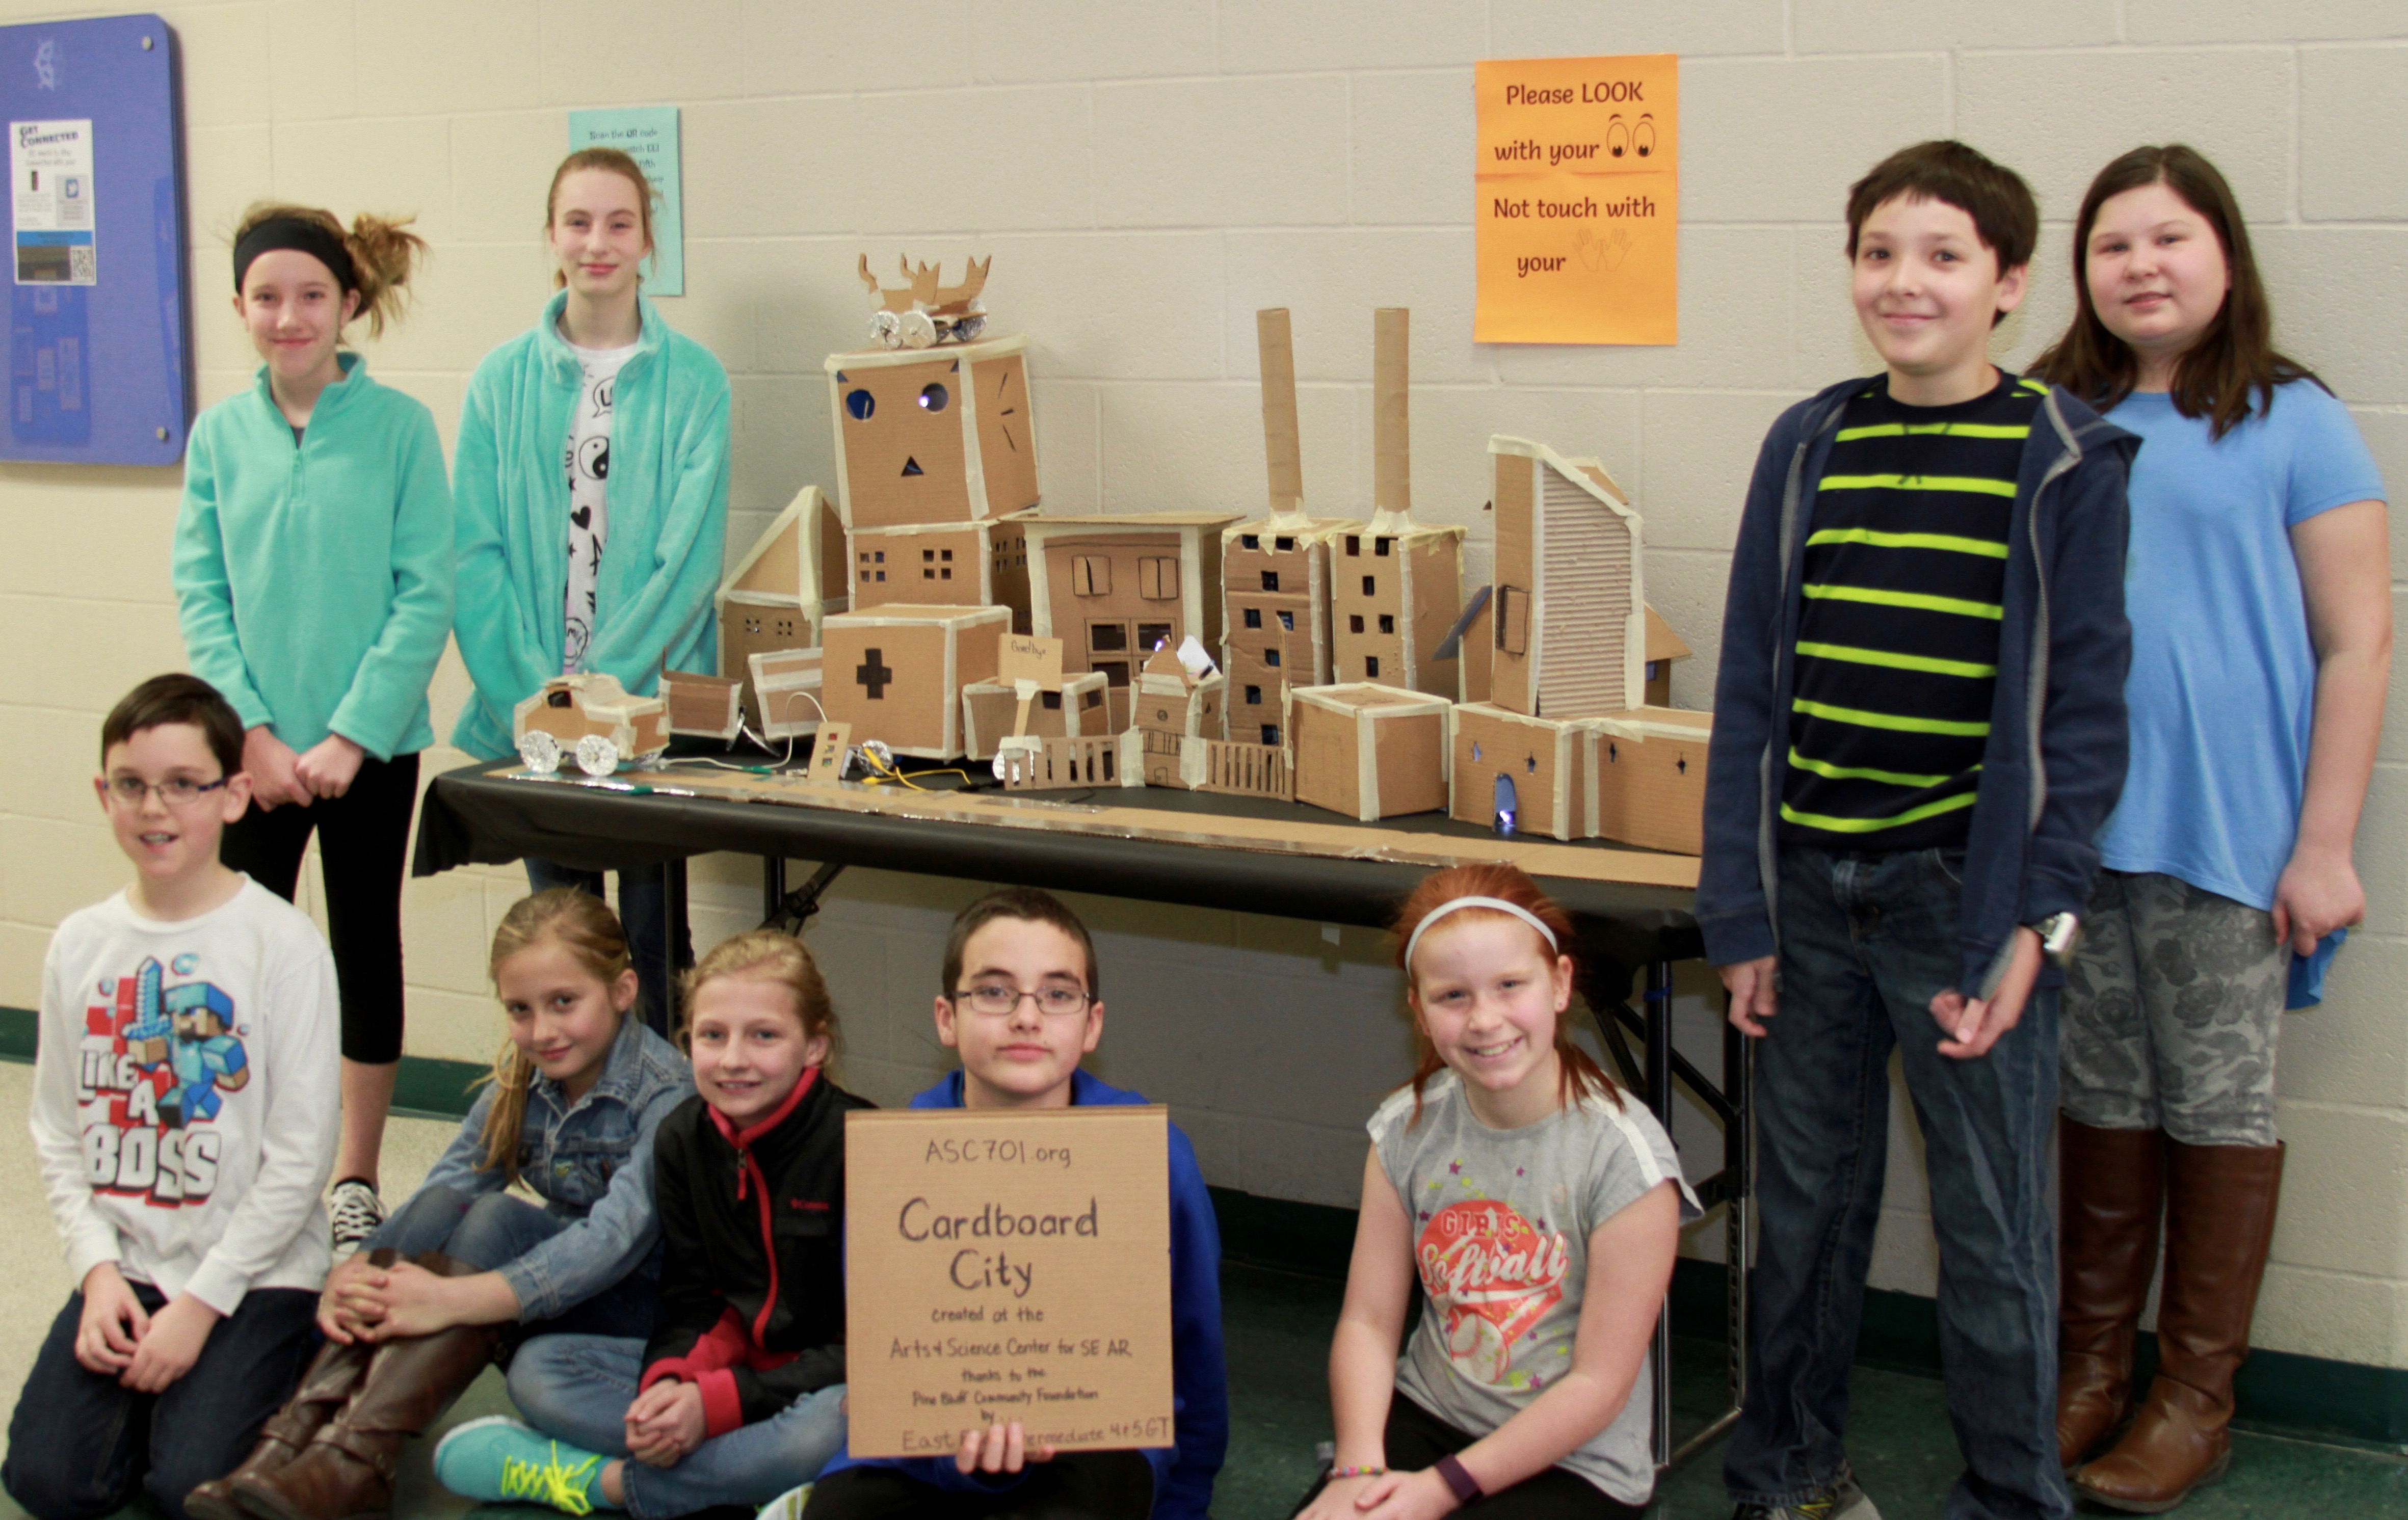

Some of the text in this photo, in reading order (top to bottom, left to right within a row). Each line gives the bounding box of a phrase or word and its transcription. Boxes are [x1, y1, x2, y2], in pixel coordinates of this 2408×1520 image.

[1506, 81, 1644, 105] Please LOOK
[1494, 140, 1600, 166] with your
[1493, 196, 1655, 218] Not touch with
[1517, 256, 1567, 278] your
[127, 1078, 161, 1126] A
[83, 1123, 222, 1204] BOSS
[925, 1139, 1071, 1168] ASC701.org
[898, 1195, 1099, 1242] Cardboard
[949, 1247, 1033, 1298] City
[931, 1304, 1045, 1323] created at the
[1007, 1337, 1051, 1356] Center
[1058, 1338, 1075, 1354] for
[1080, 1339, 1101, 1356] SE
[1106, 1339, 1133, 1357] AR
[1009, 1368, 1022, 1382] to
[1036, 1386, 1099, 1402] Foundation
[903, 1430, 956, 1451] East
